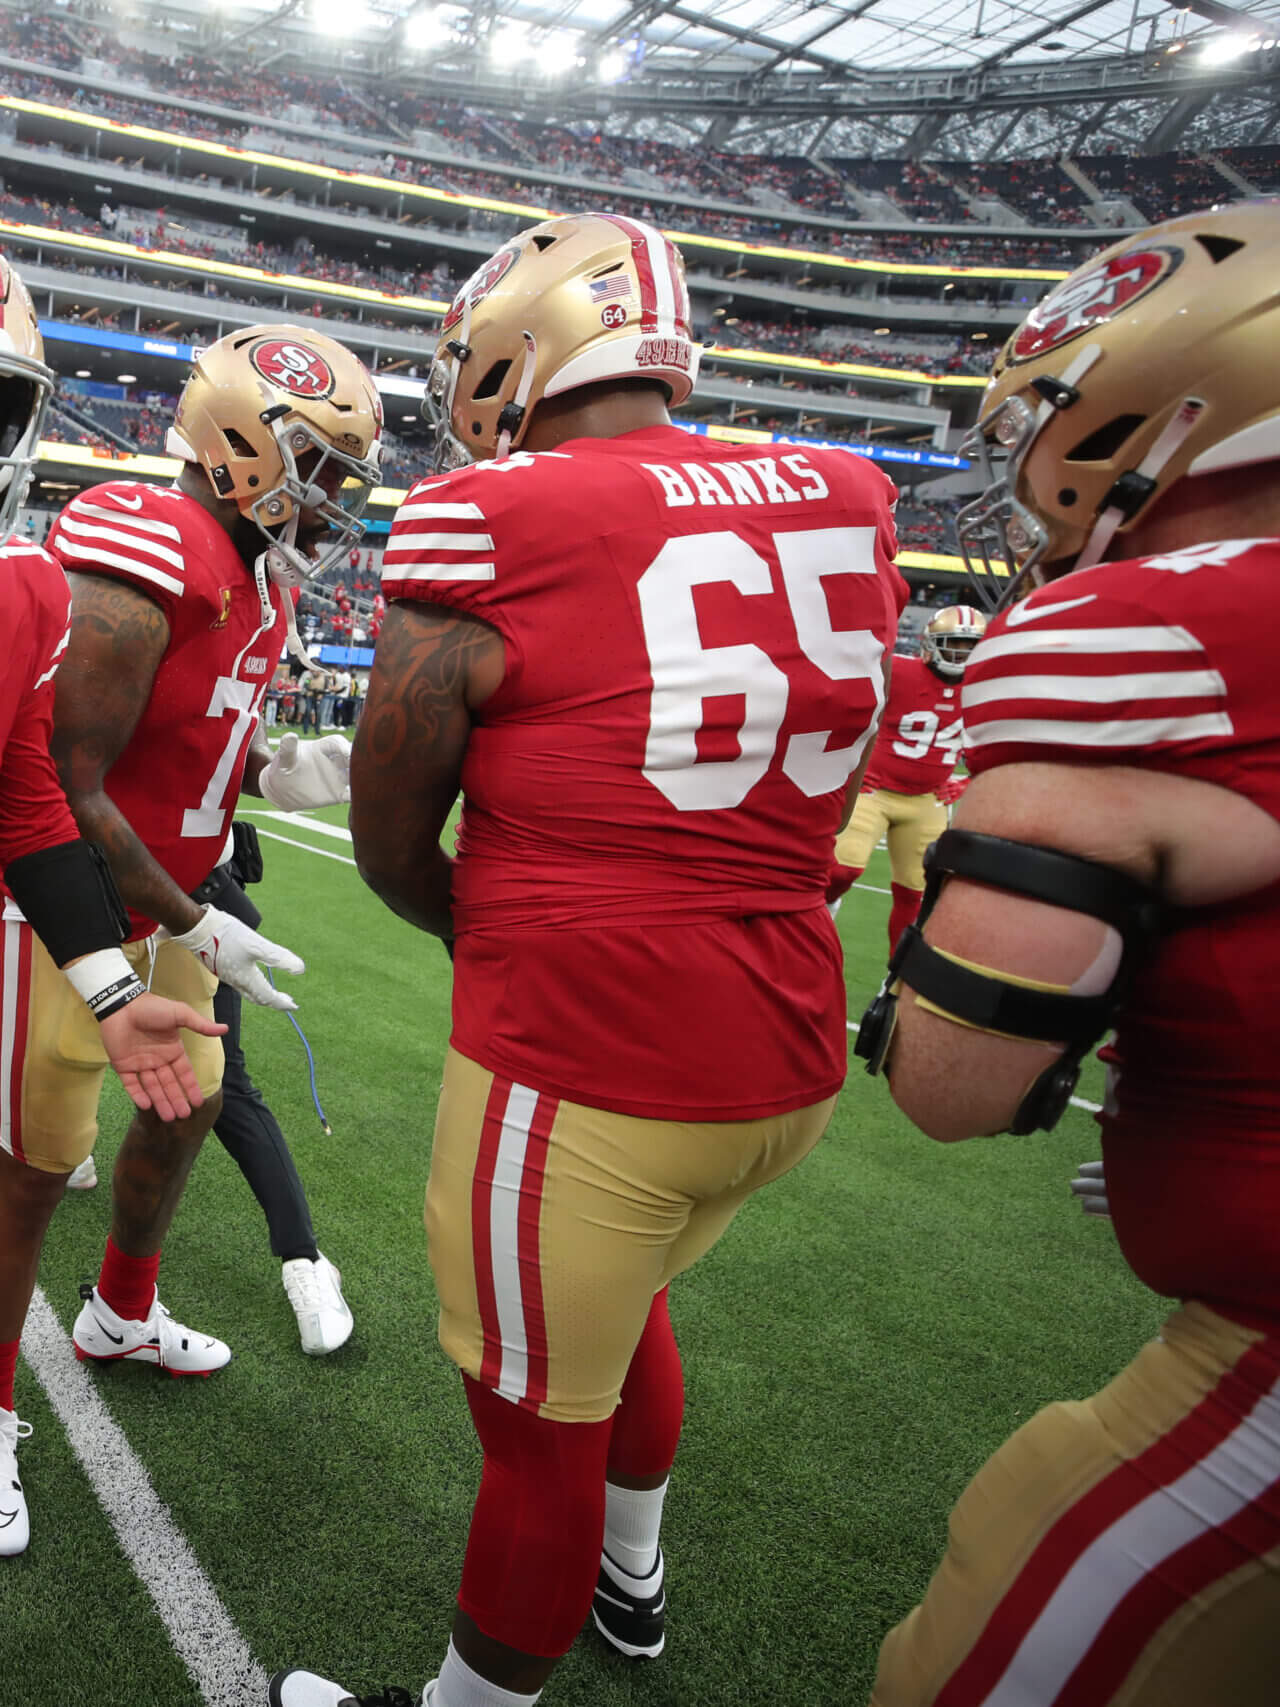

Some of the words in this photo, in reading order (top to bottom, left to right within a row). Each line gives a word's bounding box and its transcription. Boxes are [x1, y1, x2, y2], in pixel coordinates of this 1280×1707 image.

[601, 308, 625, 324] 64
[642, 454, 830, 507] BANKS
[636, 526, 886, 812] 65
[892, 711, 964, 765] 94
